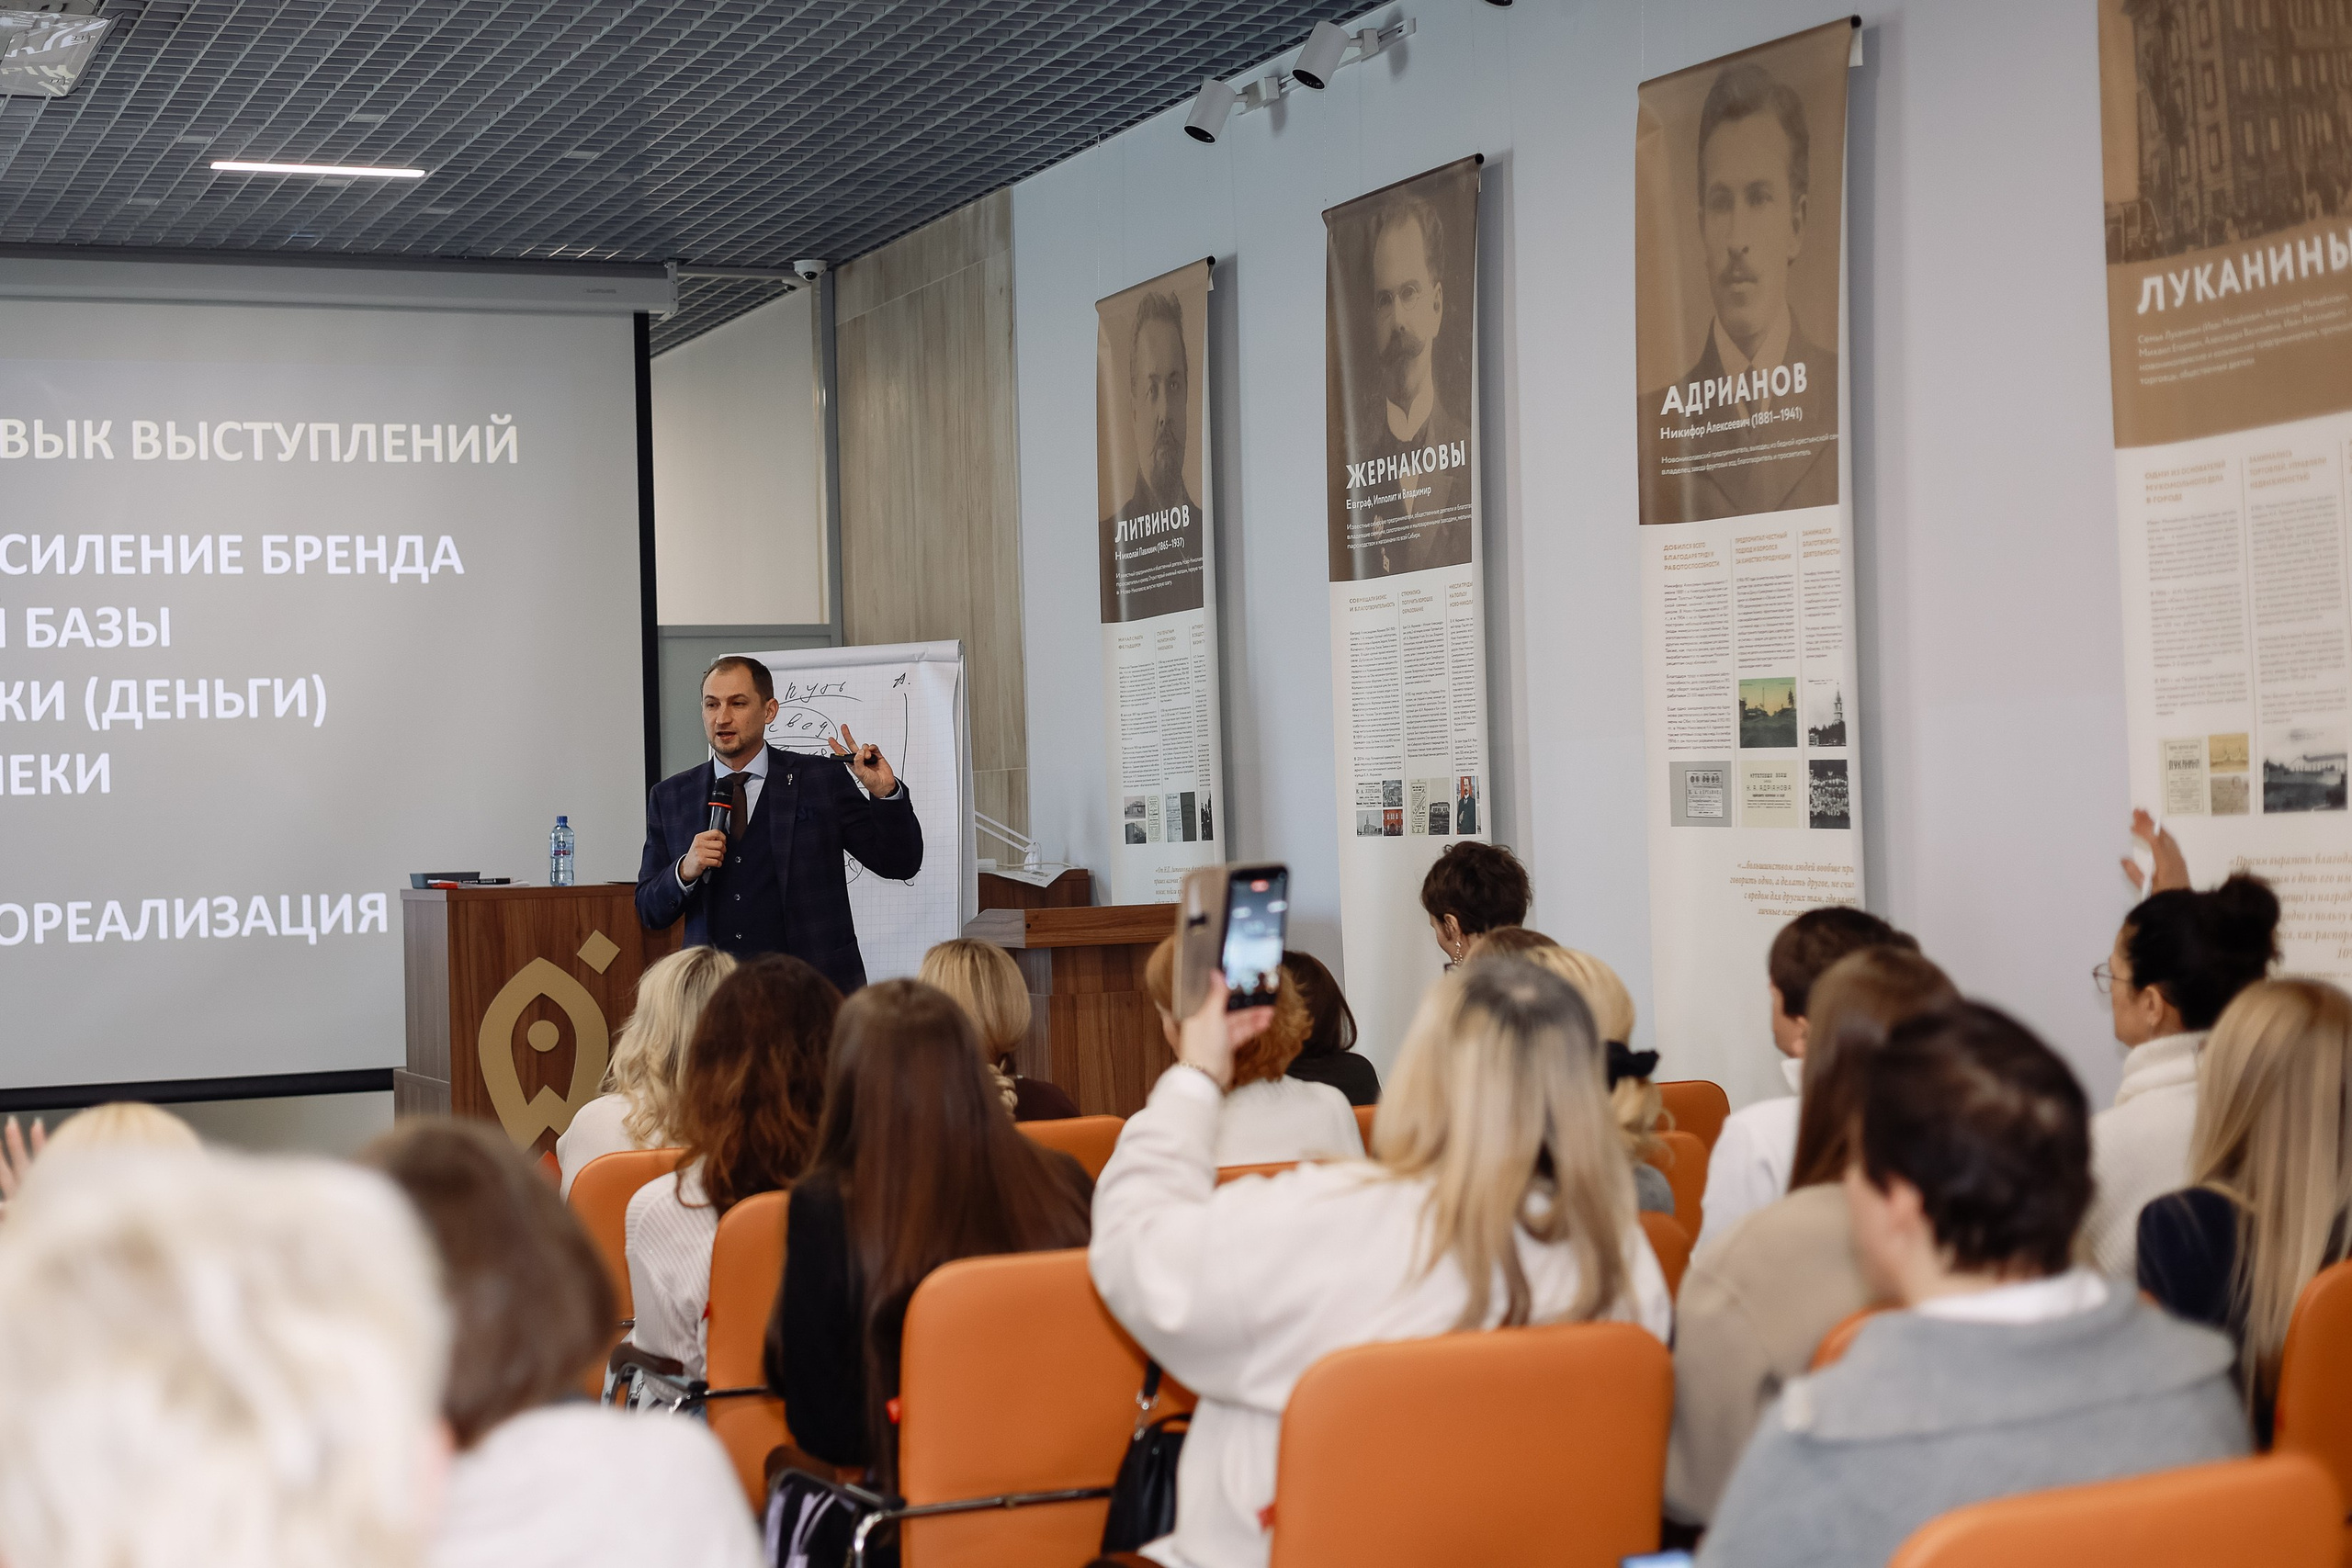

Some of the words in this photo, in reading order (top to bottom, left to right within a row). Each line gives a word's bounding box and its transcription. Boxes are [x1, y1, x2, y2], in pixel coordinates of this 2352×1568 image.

[2137, 228, 2352, 315] ЛУКАНИНЫ
[1660, 362, 1807, 417] АДРИАНОВ
[0, 418, 116, 460] ВЫК
[131, 413, 519, 464] ВЫСТУПЛЕНИЙ
[1660, 423, 1705, 440] Никифор
[1706, 418, 1750, 434] Алексеевич
[1345, 440, 1465, 490] ЖЕРНАКОВЫ
[1114, 504, 1191, 544] ЛИТВИНОВ
[1346, 494, 1374, 513] Евграф,
[1374, 492, 1397, 506] Ипполит
[1402, 486, 1432, 500] Владимир
[0, 533, 244, 576] СИЛЕНИЕ
[261, 535, 465, 584] БРЕНДА
[1114, 547, 1139, 561] Николай
[26, 605, 172, 649] БАЗЫ
[85, 674, 327, 731] (ДЕНЬГИ)
[0, 752, 111, 796] ЕКИ
[0, 892, 389, 946] ОРЕАЛИЗАЦИЯ
